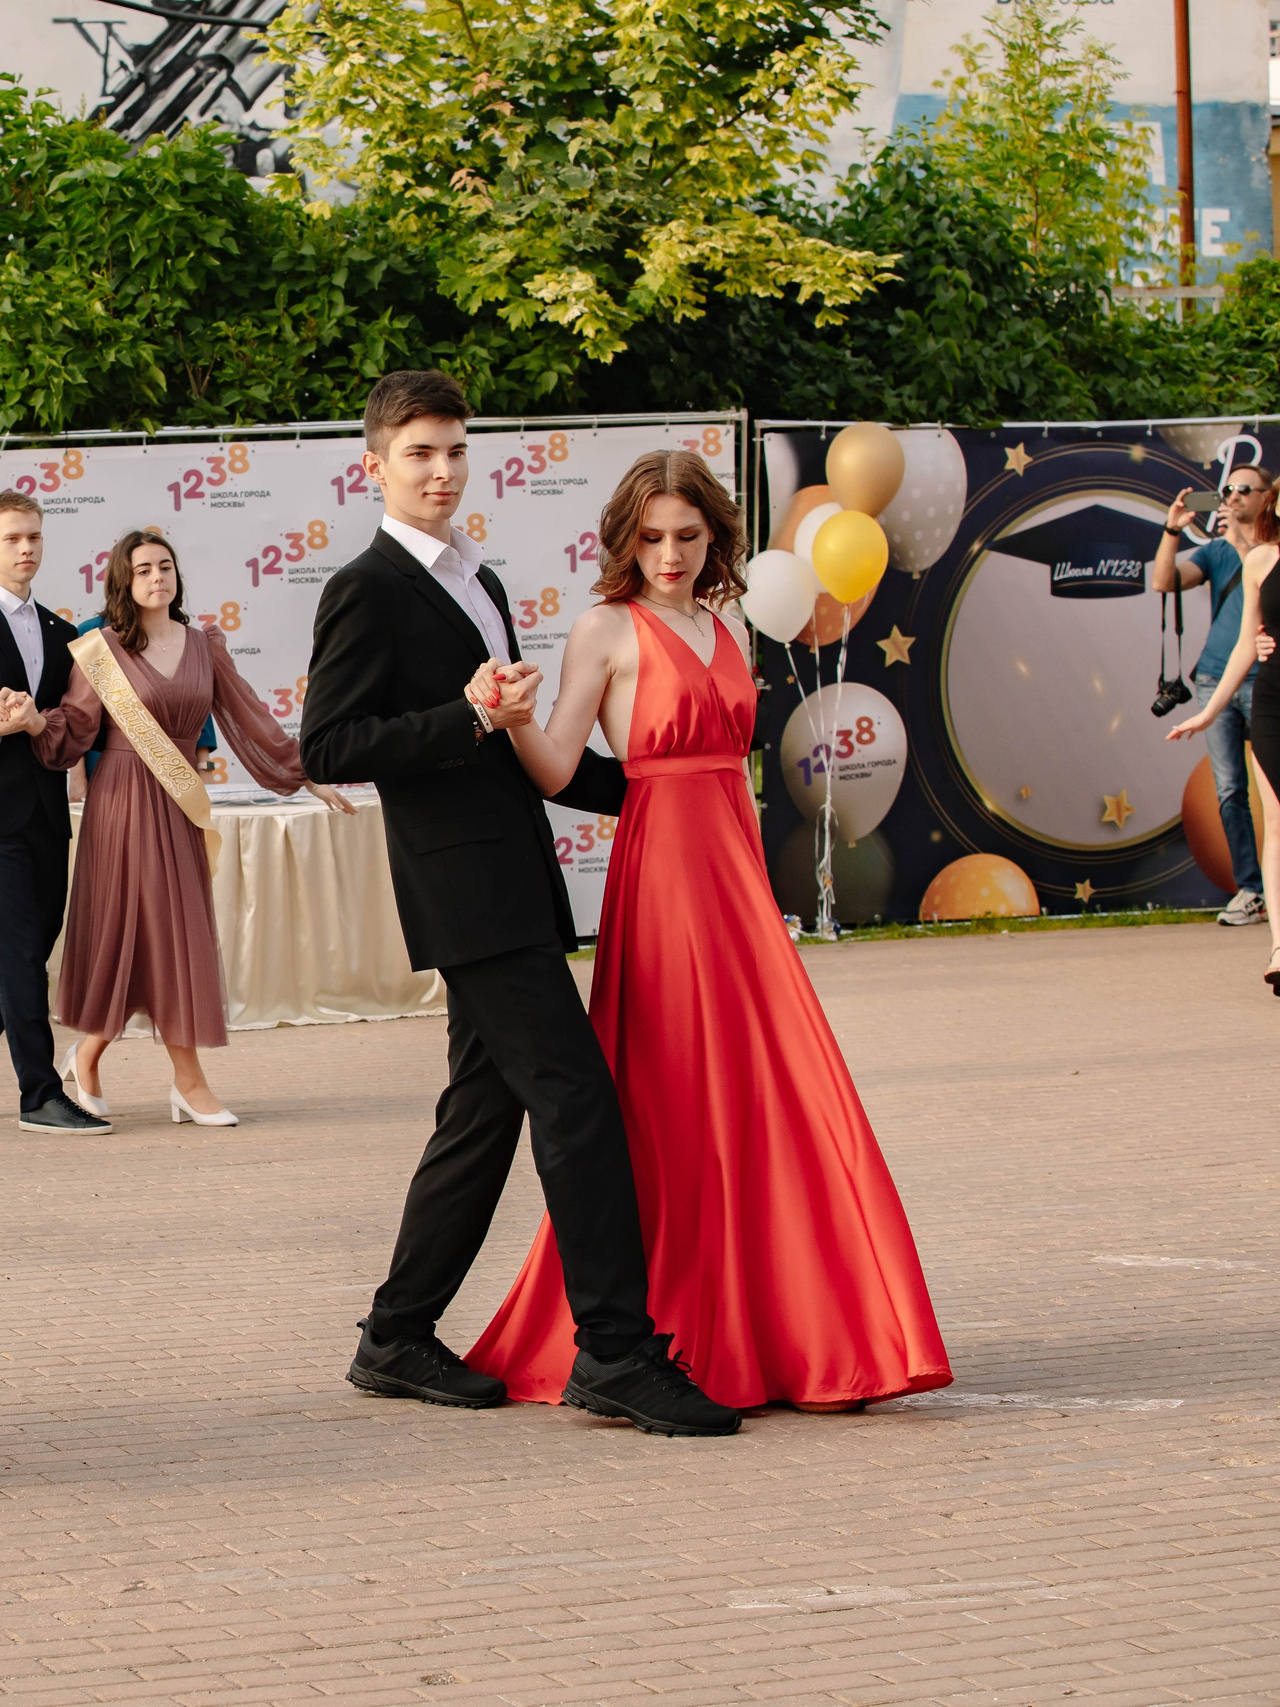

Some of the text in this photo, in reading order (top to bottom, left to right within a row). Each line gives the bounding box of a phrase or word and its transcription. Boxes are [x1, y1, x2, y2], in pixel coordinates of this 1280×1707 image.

[1, 449, 84, 502] 238
[167, 444, 250, 512] 1238
[331, 463, 368, 506] 12
[490, 432, 569, 499] 1238
[43, 507, 78, 515] МОСКВЫ
[73, 496, 105, 504] ГОРОДА
[210, 490, 271, 499] ШКОЛА ГОРОДА
[246, 520, 329, 587] 1238
[564, 532, 598, 573] 12
[519, 587, 560, 629] 38
[230, 647, 261, 655] ГОРОДА
[102, 678, 198, 792] Выпускник 2023
[554, 814, 616, 864] 238
